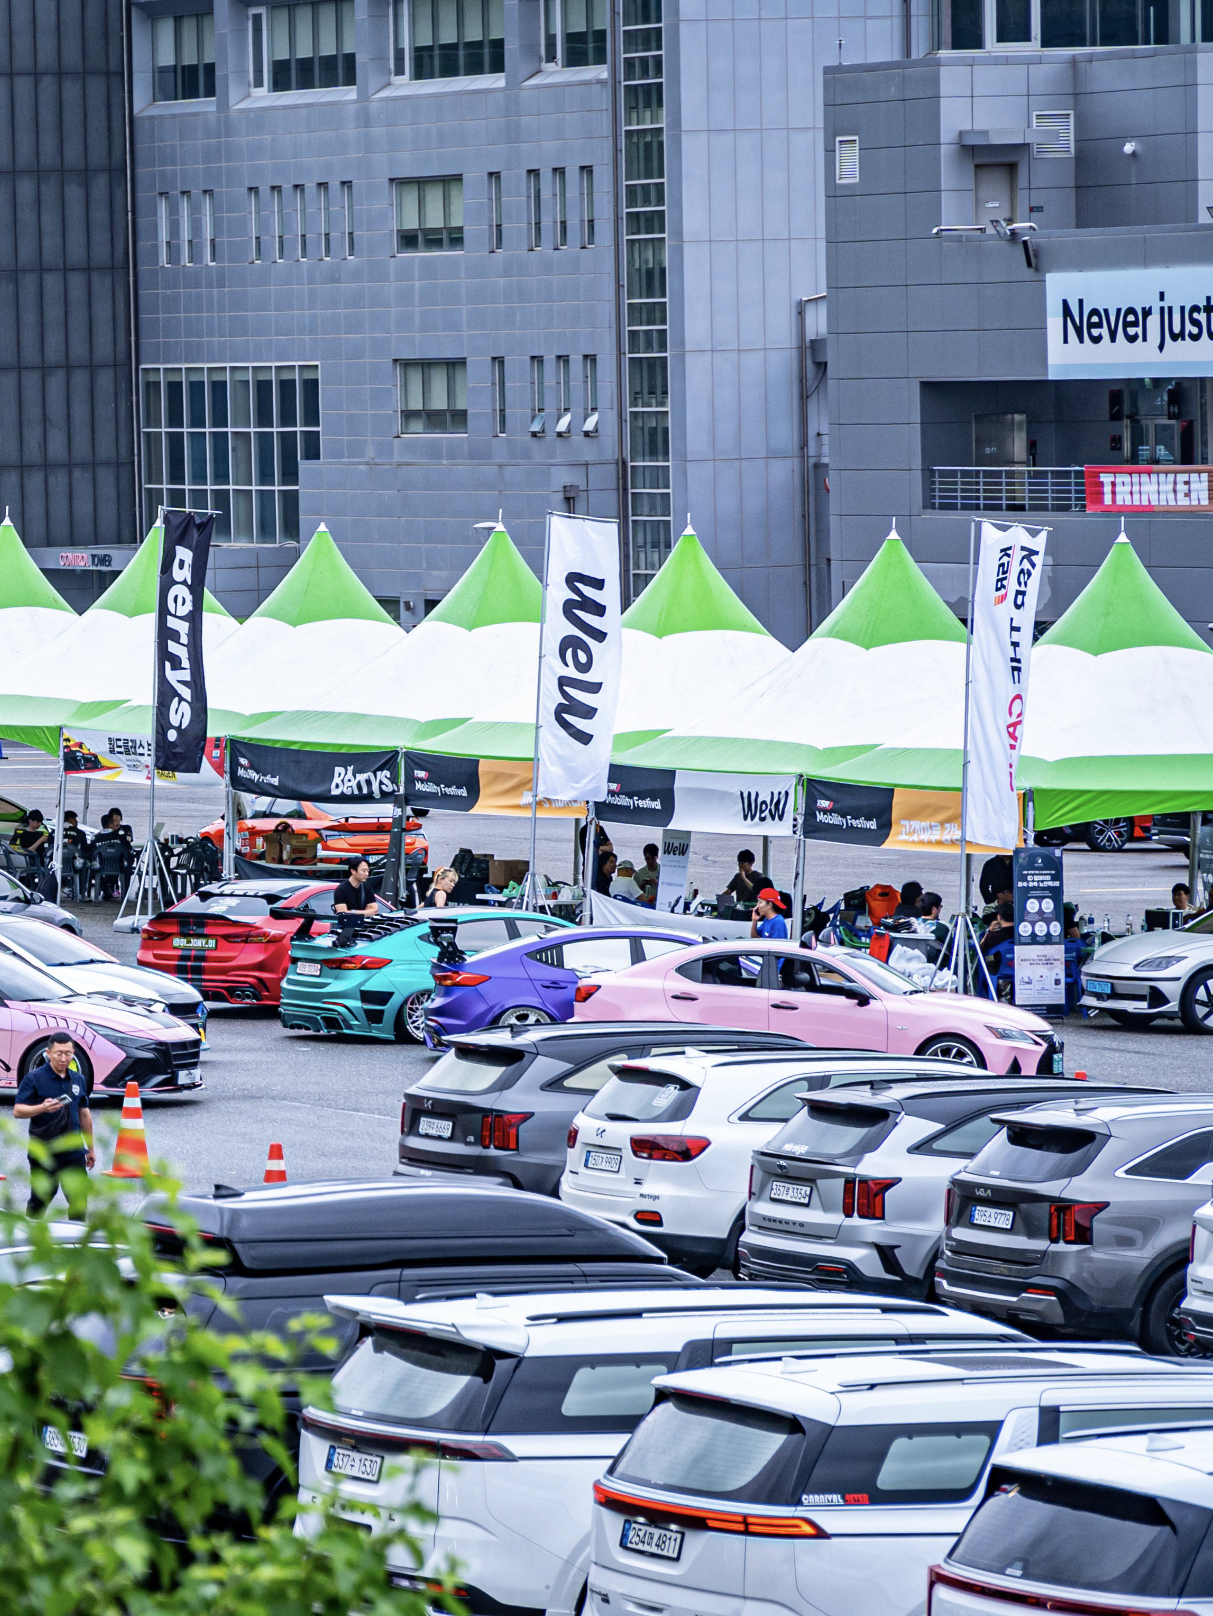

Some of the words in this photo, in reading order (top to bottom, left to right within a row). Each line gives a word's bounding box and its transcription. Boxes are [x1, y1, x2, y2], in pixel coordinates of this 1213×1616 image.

[1062, 298, 1152, 344] Never
[1158, 291, 1213, 353] just
[1099, 473, 1208, 505] TRINKEN
[60, 553, 90, 566] CONTROL
[90, 554, 113, 567] TOWER
[553, 571, 608, 746] WeW
[415, 780, 440, 796] Mobility
[440, 785, 468, 797] Festival
[634, 797, 662, 810] Festival
[739, 790, 789, 822] WeW
[816, 811, 847, 829] Mobility
[847, 815, 877, 830] Festival
[663, 841, 689, 856] WeW
[790, 1187, 807, 1200] 3354
[762, 1216, 805, 1228] SORENTO
[994, 1212, 1011, 1226] 9778
[333, 1451, 356, 1472] 337수
[357, 1456, 378, 1477] 1530
[801, 1493, 844, 1505] CARNIVAL
[655, 1532, 678, 1554] 4811
